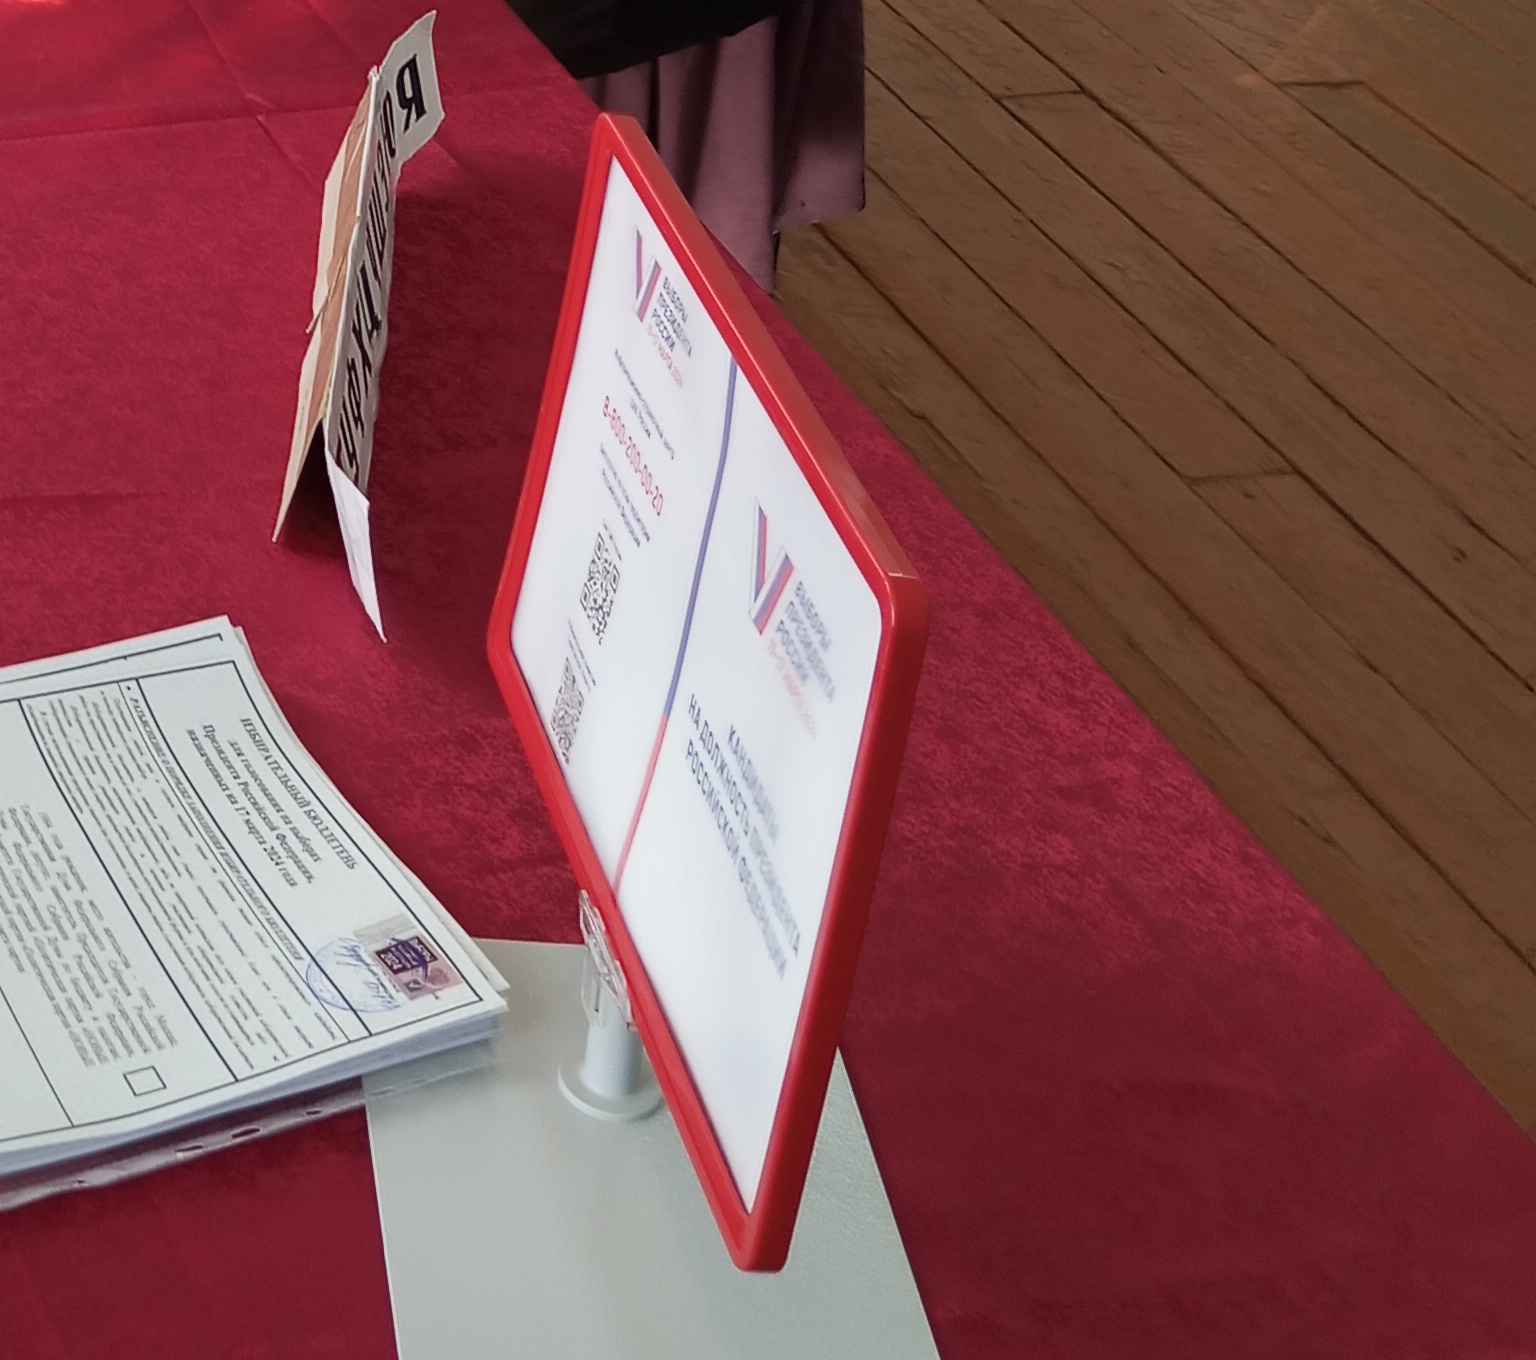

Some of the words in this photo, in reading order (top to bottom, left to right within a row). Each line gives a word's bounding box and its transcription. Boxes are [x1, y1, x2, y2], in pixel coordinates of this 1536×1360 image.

[652, 308, 676, 353] РОССИИ
[658, 292, 692, 357] ПРЕЗИДЕНТА
[663, 276, 689, 325] ВЫБОРЫ
[602, 396, 664, 517] 8-800-200-00-20
[775, 620, 810, 684] РОССИИ
[785, 601, 836, 703] ПРЕЗИДЕНТА
[795, 581, 832, 653] ВЫБОРЫ
[187, 730, 229, 792] назначенных
[226, 794, 238, 804] на
[235, 807, 250, 815] 17
[244, 819, 266, 845] марта
[264, 846, 283, 865] 2024
[279, 868, 297, 886] года
[203, 725, 241, 780] Президента
[238, 781, 279, 831] Российской
[228, 741, 244, 757] для
[241, 759, 284, 813] голосования
[280, 815, 292, 825] на
[289, 827, 321, 862] выборах
[241, 719, 310, 808] ИЗБИРАТЕЛЬНЫЙ
[304, 809, 357, 869] БЮЛЛЕТЕНЬ
[687, 693, 701, 733] НА
[699, 720, 750, 836] ДОЛЖНОСТЬ
[748, 823, 802, 958] ПРЕЗИДЕНТА
[728, 724, 780, 844] КАНДИДАТЫ
[686, 737, 740, 866] РОССИЙСКОЙ
[738, 856, 789, 982] ФЕДЕРАЦИИ
[377, 949, 404, 971] 2024
